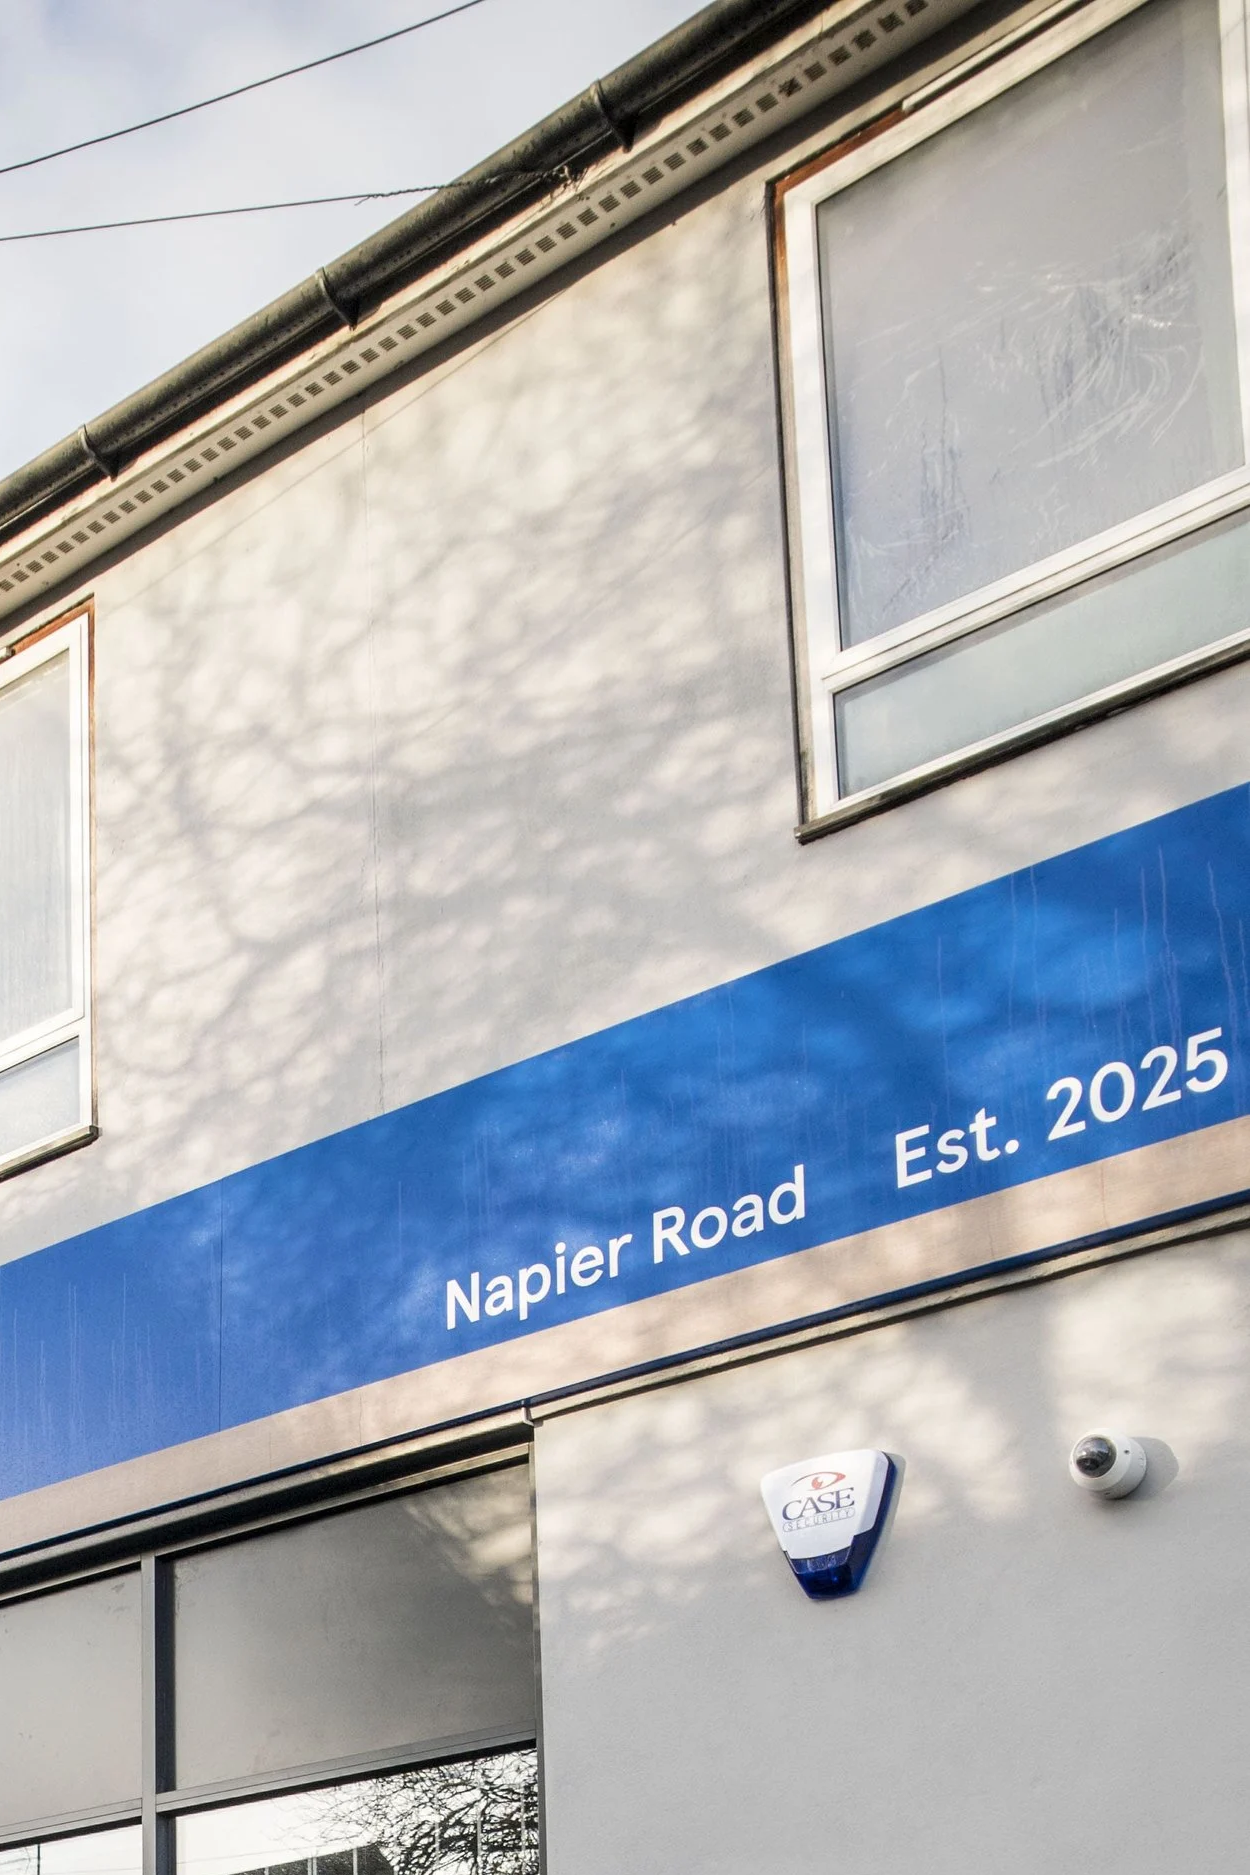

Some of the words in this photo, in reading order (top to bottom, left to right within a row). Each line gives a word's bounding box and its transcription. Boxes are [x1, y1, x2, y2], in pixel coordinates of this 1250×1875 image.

[894, 1107, 1020, 1189] Est.
[1045, 1026, 1230, 1142] 2025
[444, 1232, 633, 1330] Napier
[651, 1166, 807, 1264] Road
[782, 1486, 855, 1521] CASE
[787, 1509, 851, 1532] SECURITY
